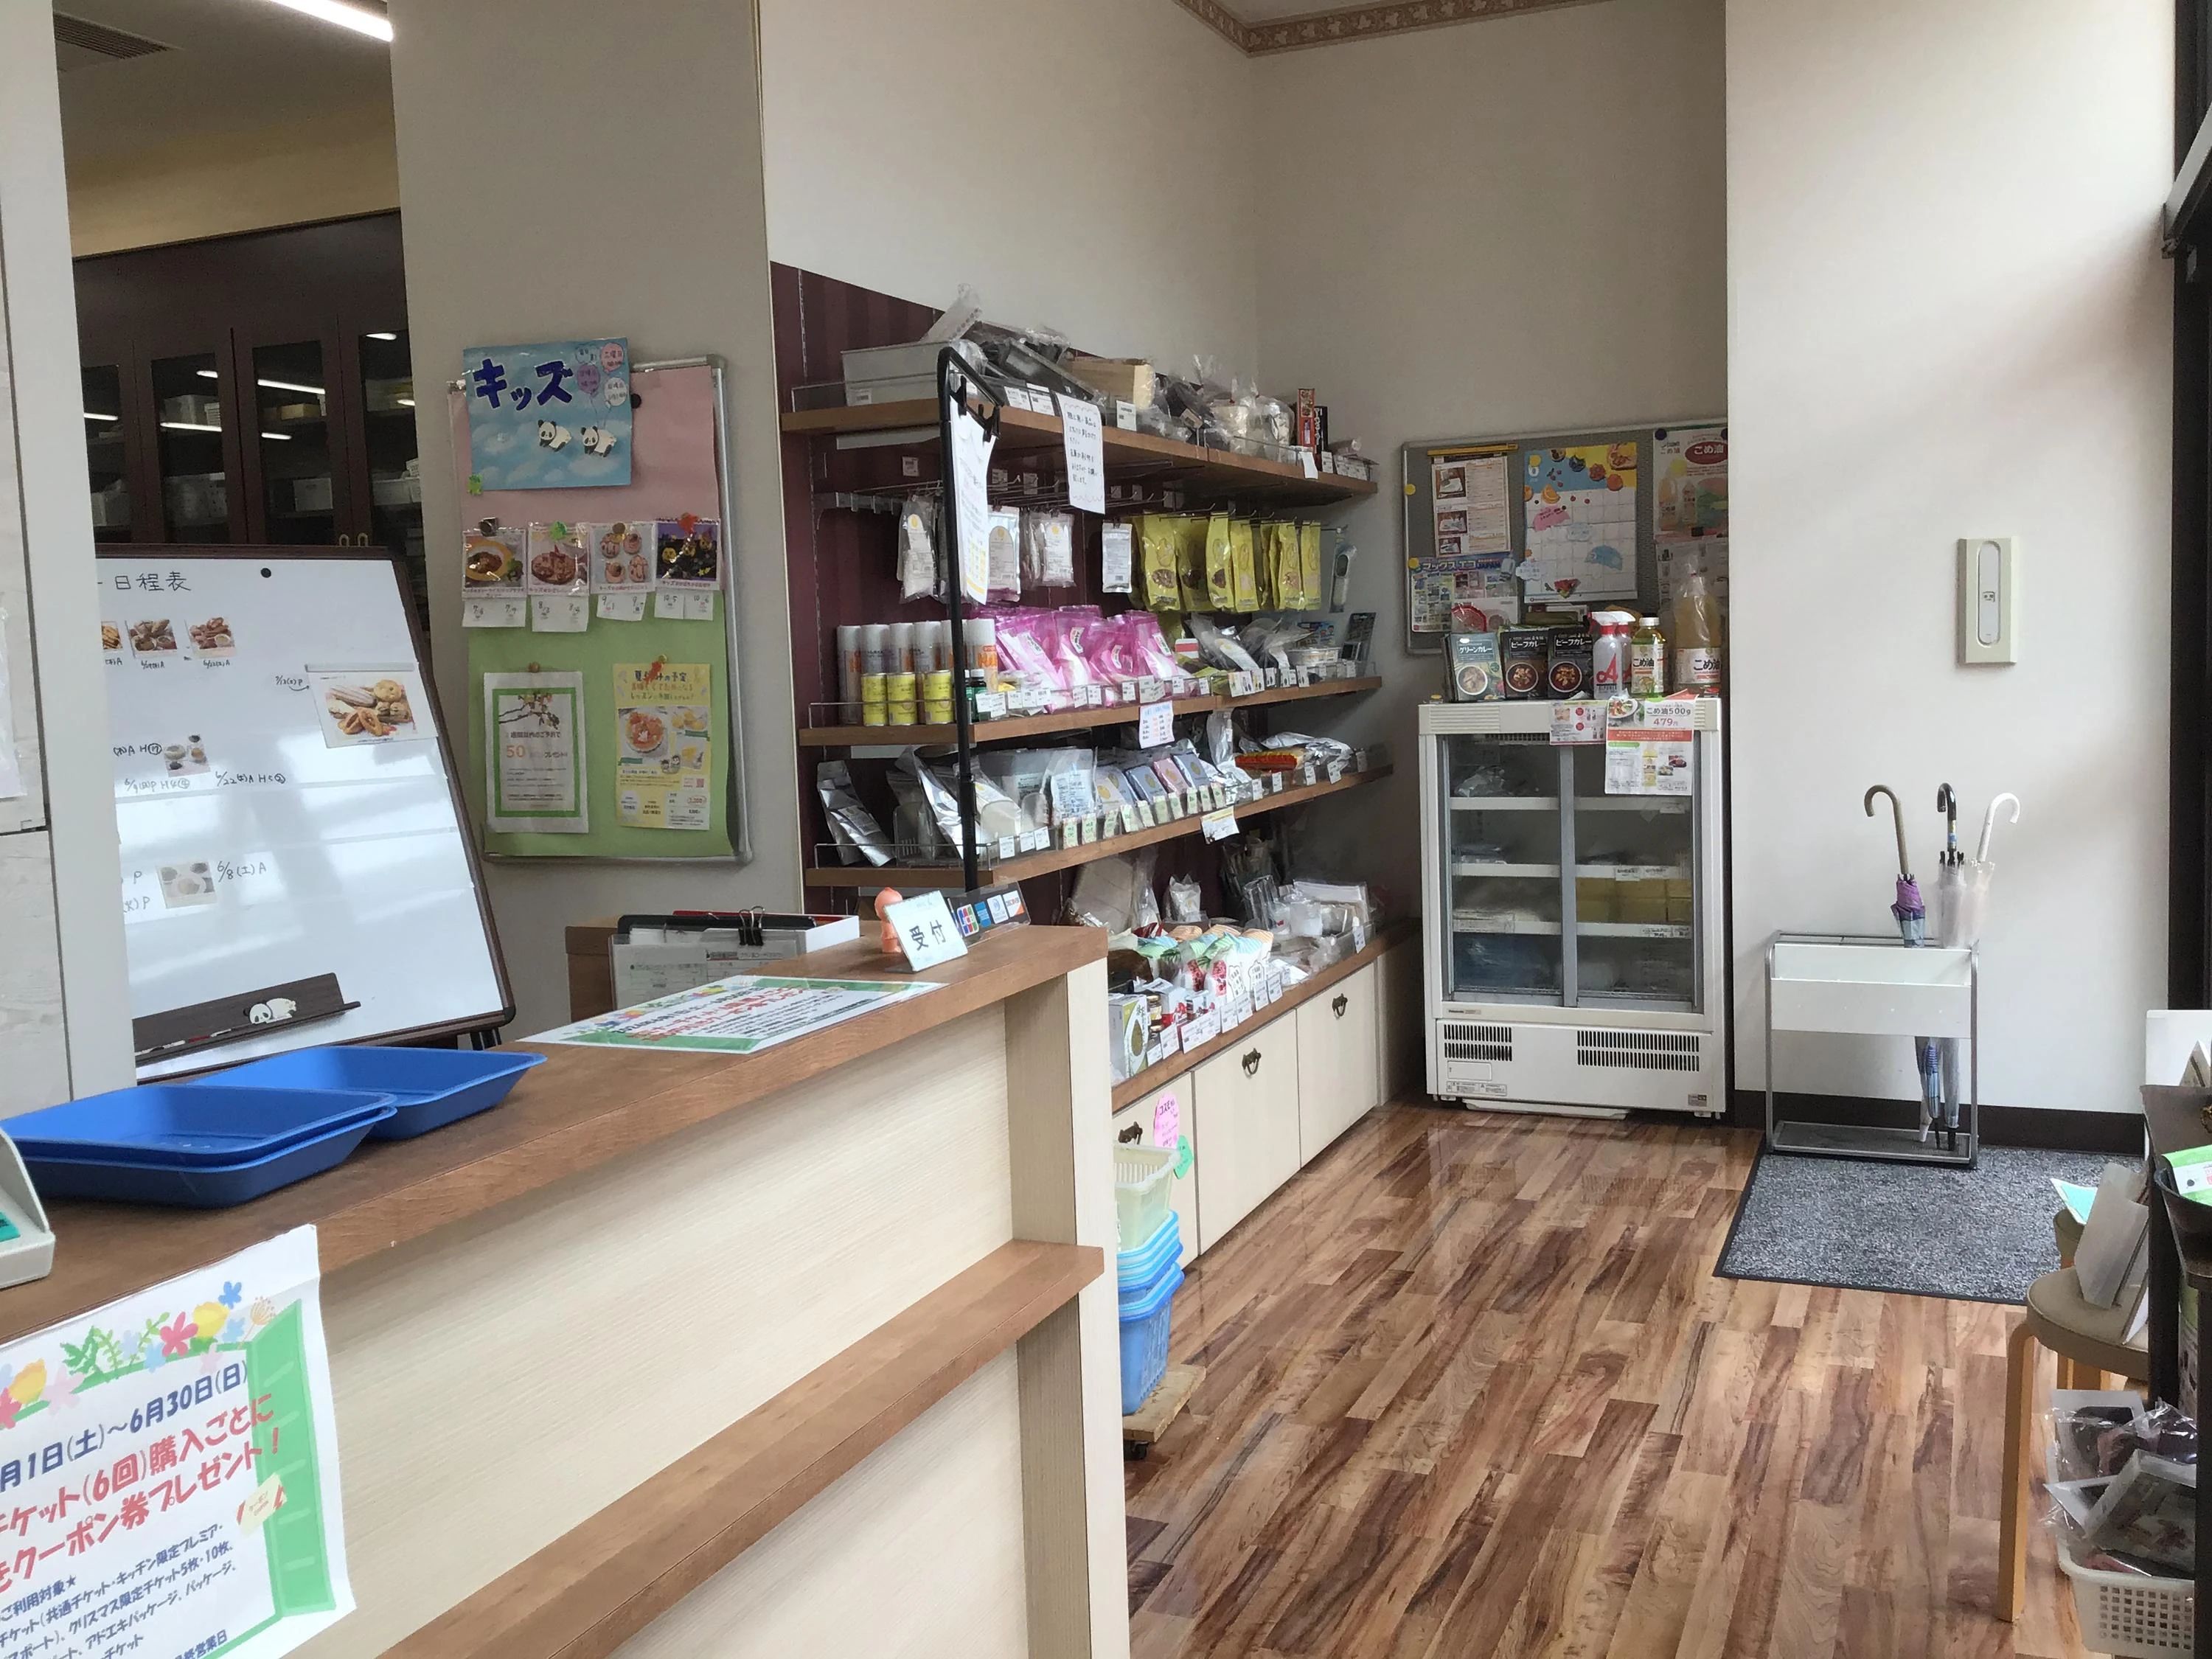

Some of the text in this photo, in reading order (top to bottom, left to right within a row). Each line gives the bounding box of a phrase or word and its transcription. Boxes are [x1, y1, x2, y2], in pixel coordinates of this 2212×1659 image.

[473, 358, 574, 411] キッズ
[1511, 641, 1546, 649] ビーフカレー
[1555, 639, 1593, 647] ビーフカレー
[1632, 658, 1655, 667] こめ油
[1693, 658, 1720, 671] こめ油
[1646, 707, 1691, 715] こめ油500g
[507, 745, 526, 758] 50
[908, 919, 947, 952] 受付
